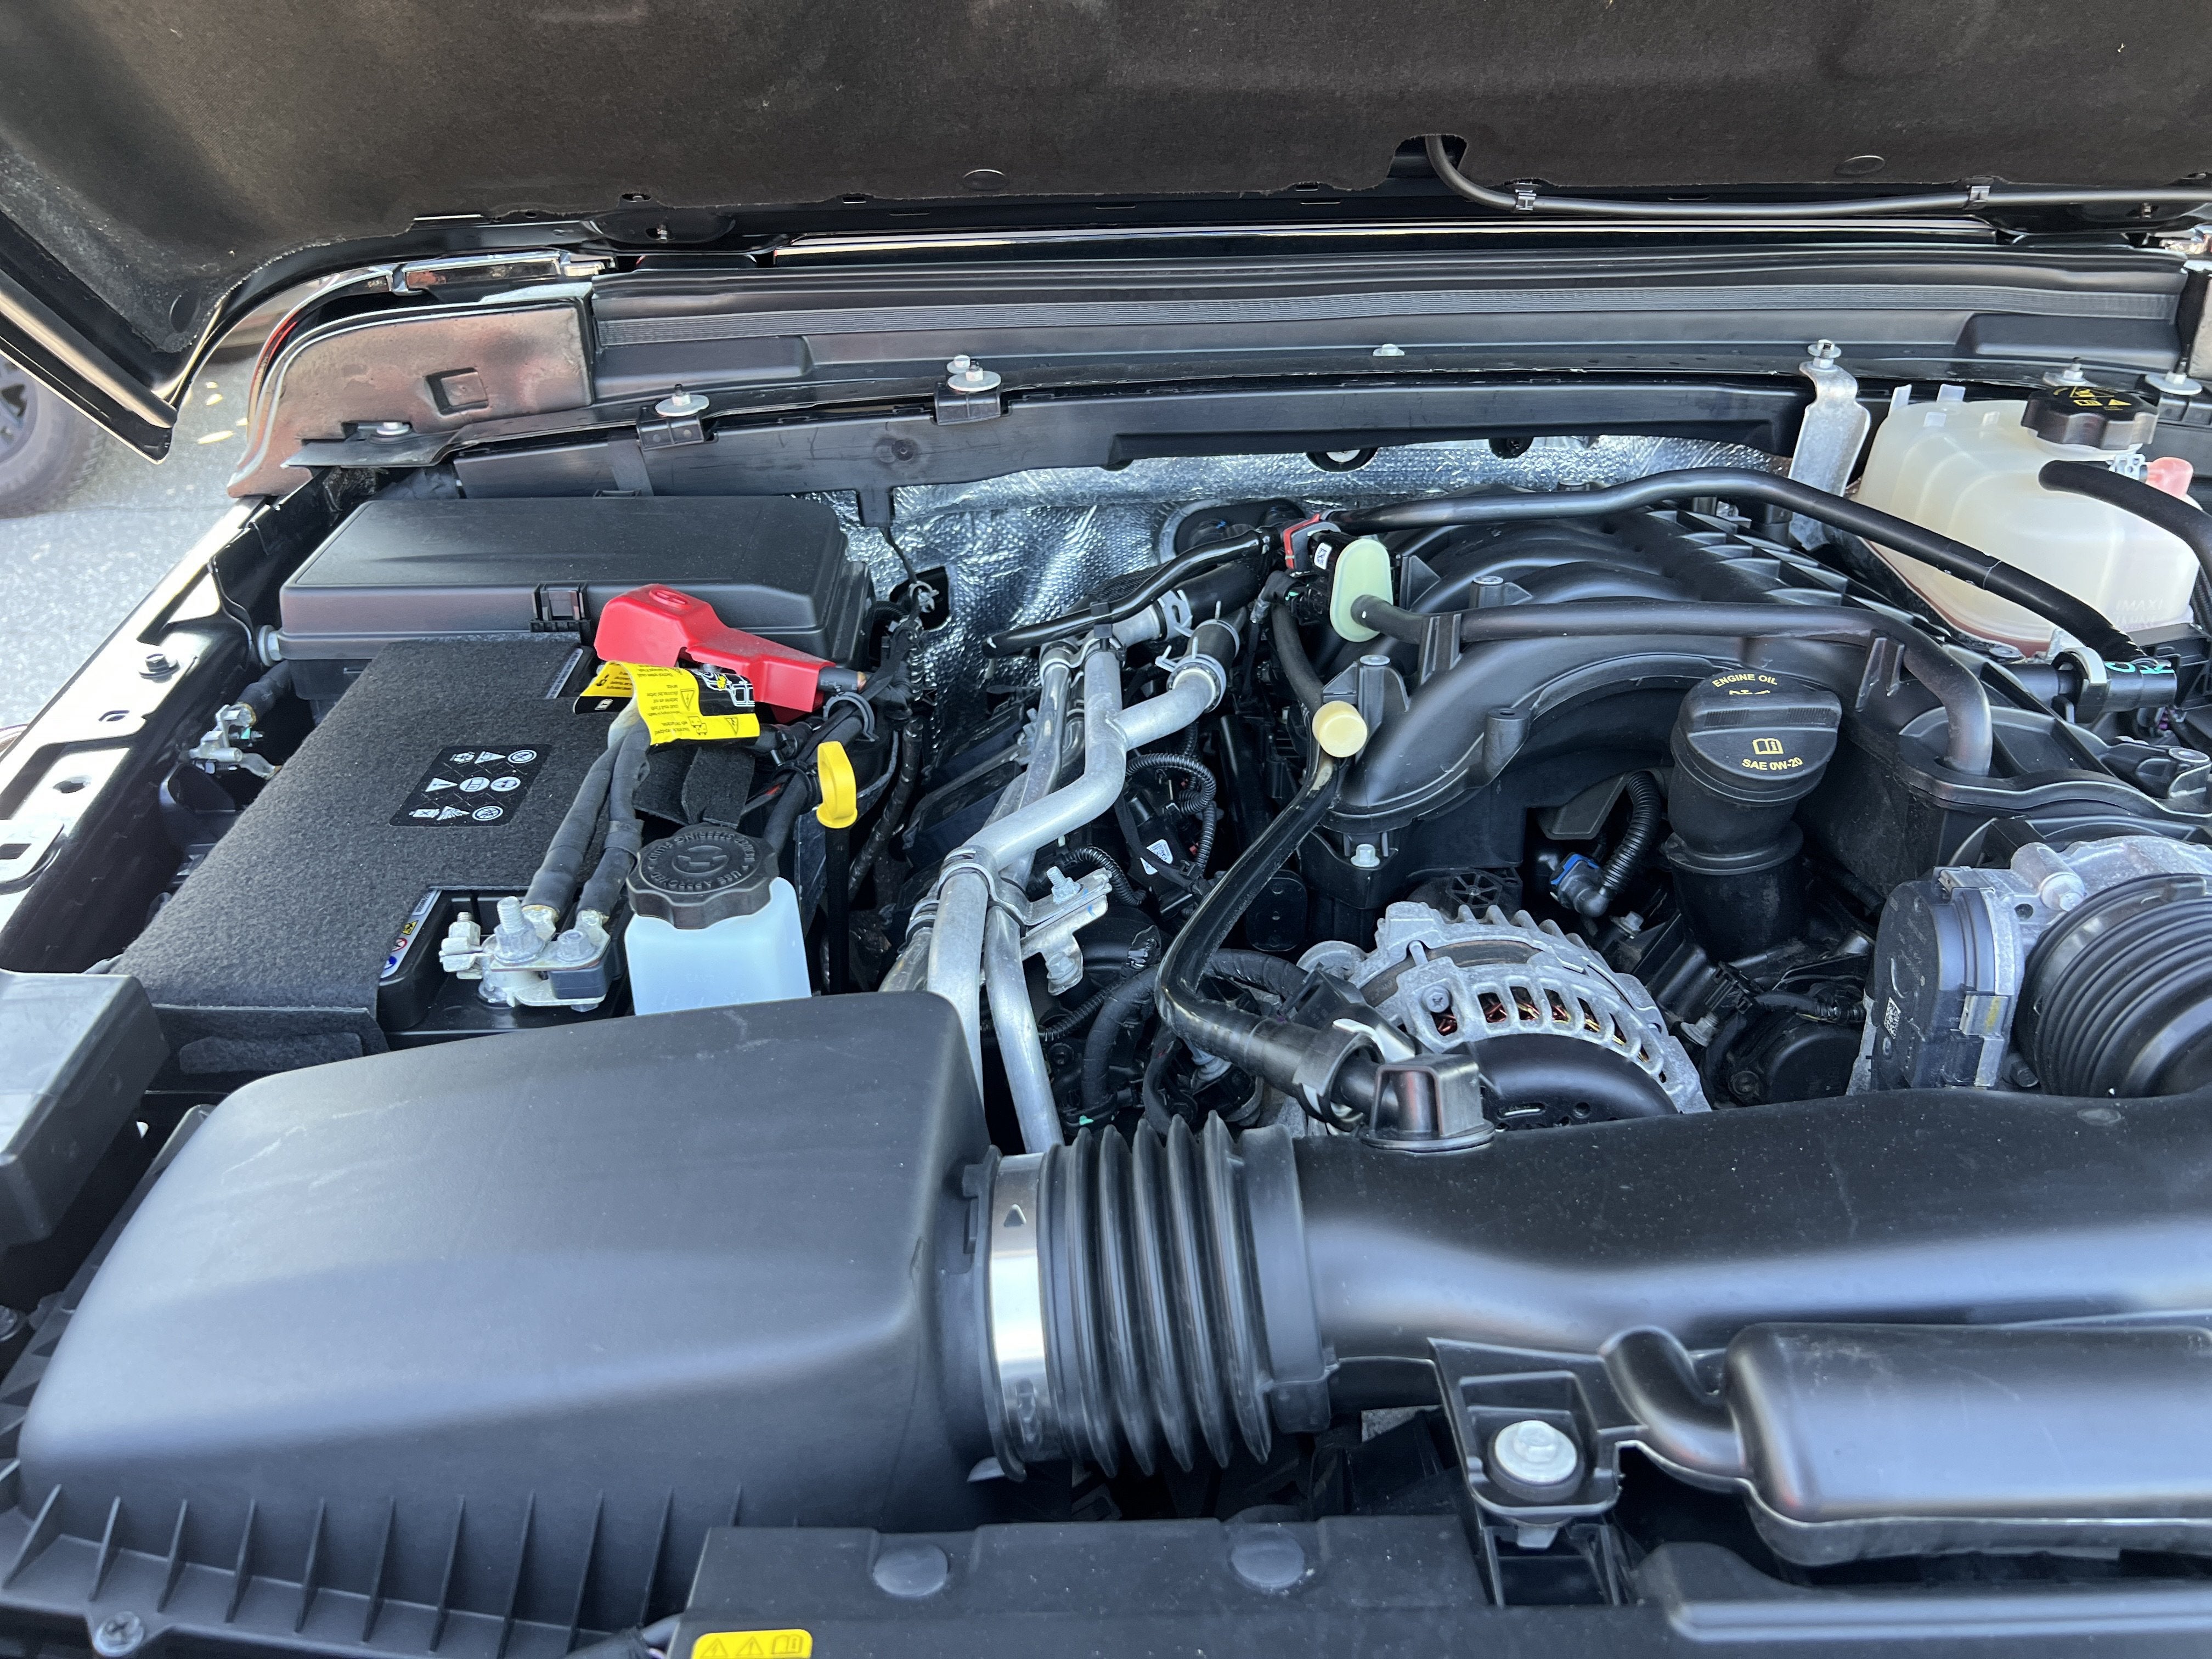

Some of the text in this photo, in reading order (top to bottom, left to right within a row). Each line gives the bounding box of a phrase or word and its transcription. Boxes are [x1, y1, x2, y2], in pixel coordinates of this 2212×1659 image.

[1712, 673, 1778, 688] ENGINE OIL
[1741, 757, 1804, 771] SAE 0W-20
[674, 831, 735, 843] STEERING
[648, 841, 674, 861] FLUID
[650, 870, 742, 891] USE APPROVED
